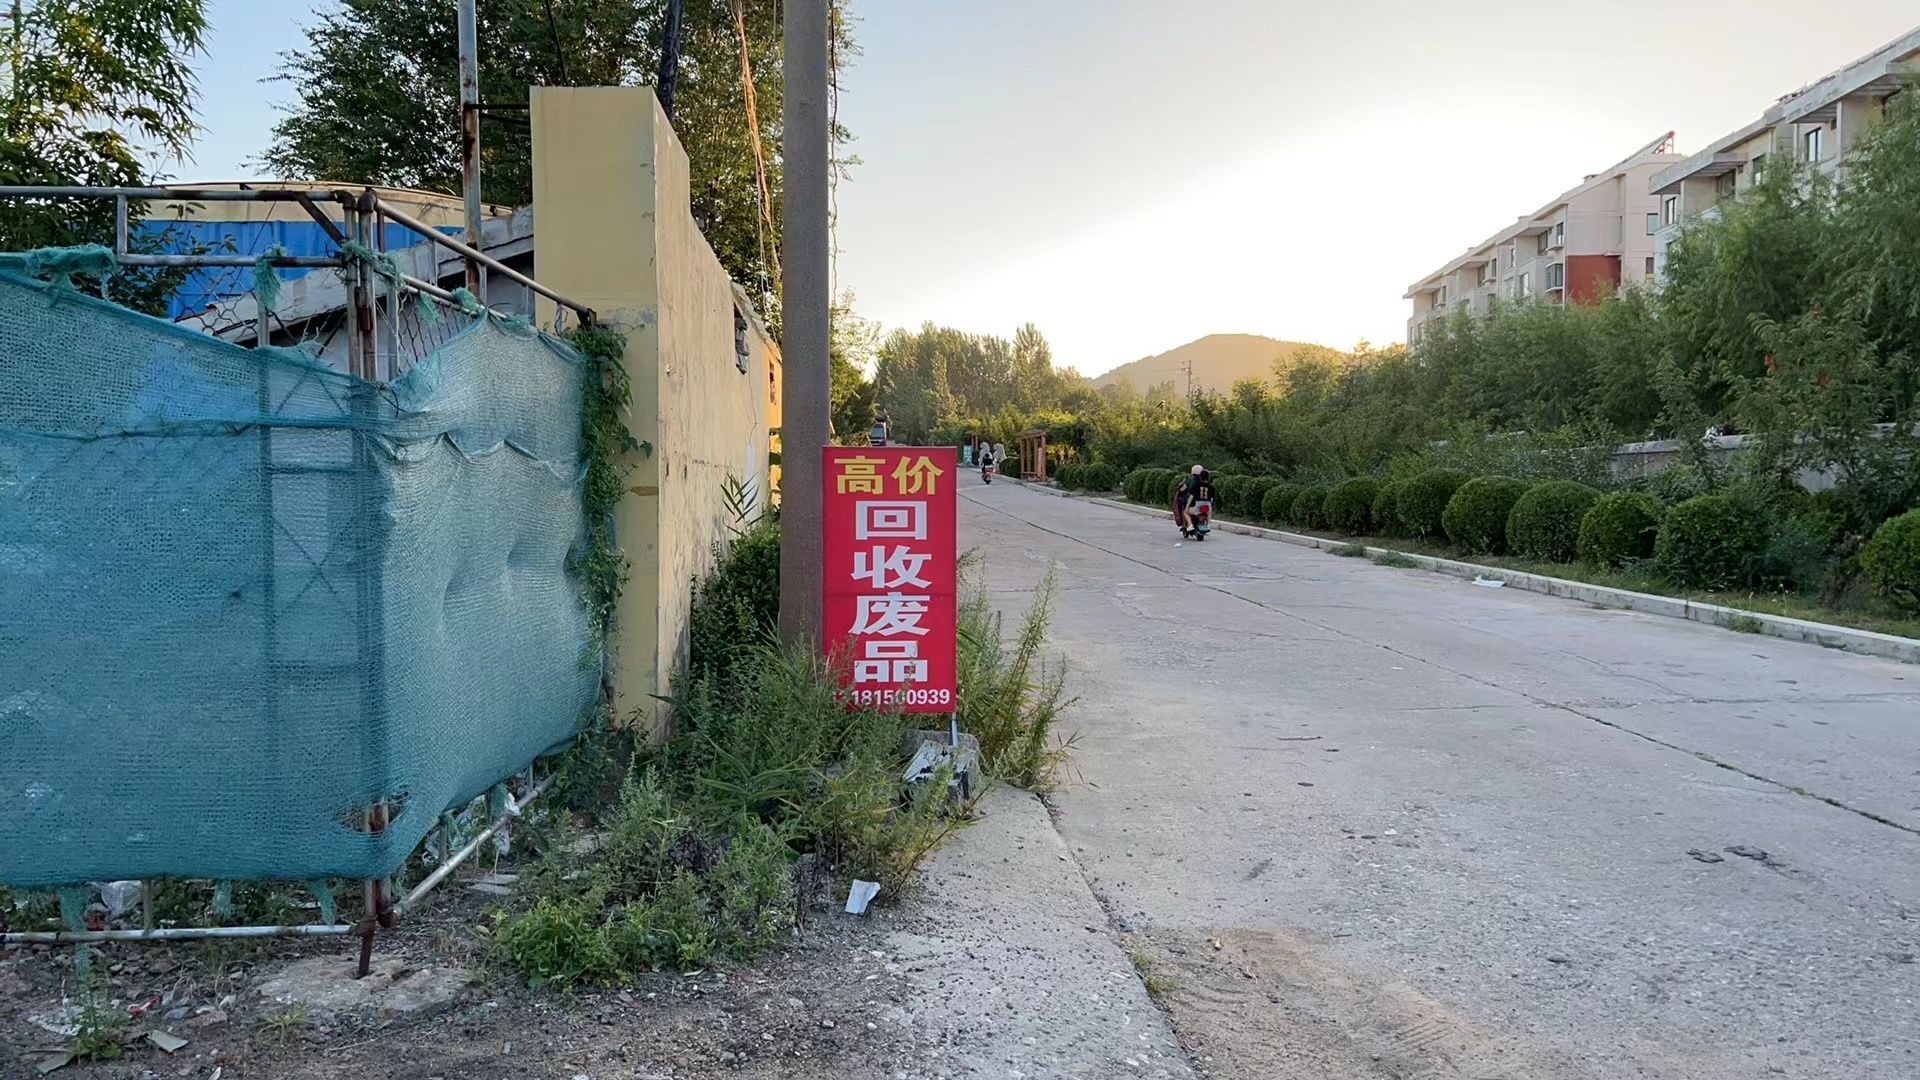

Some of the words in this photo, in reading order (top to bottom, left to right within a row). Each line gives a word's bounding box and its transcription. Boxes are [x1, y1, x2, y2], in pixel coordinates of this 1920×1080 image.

[834, 455, 944, 496] 高价
[848, 500, 932, 683] 回收废品
